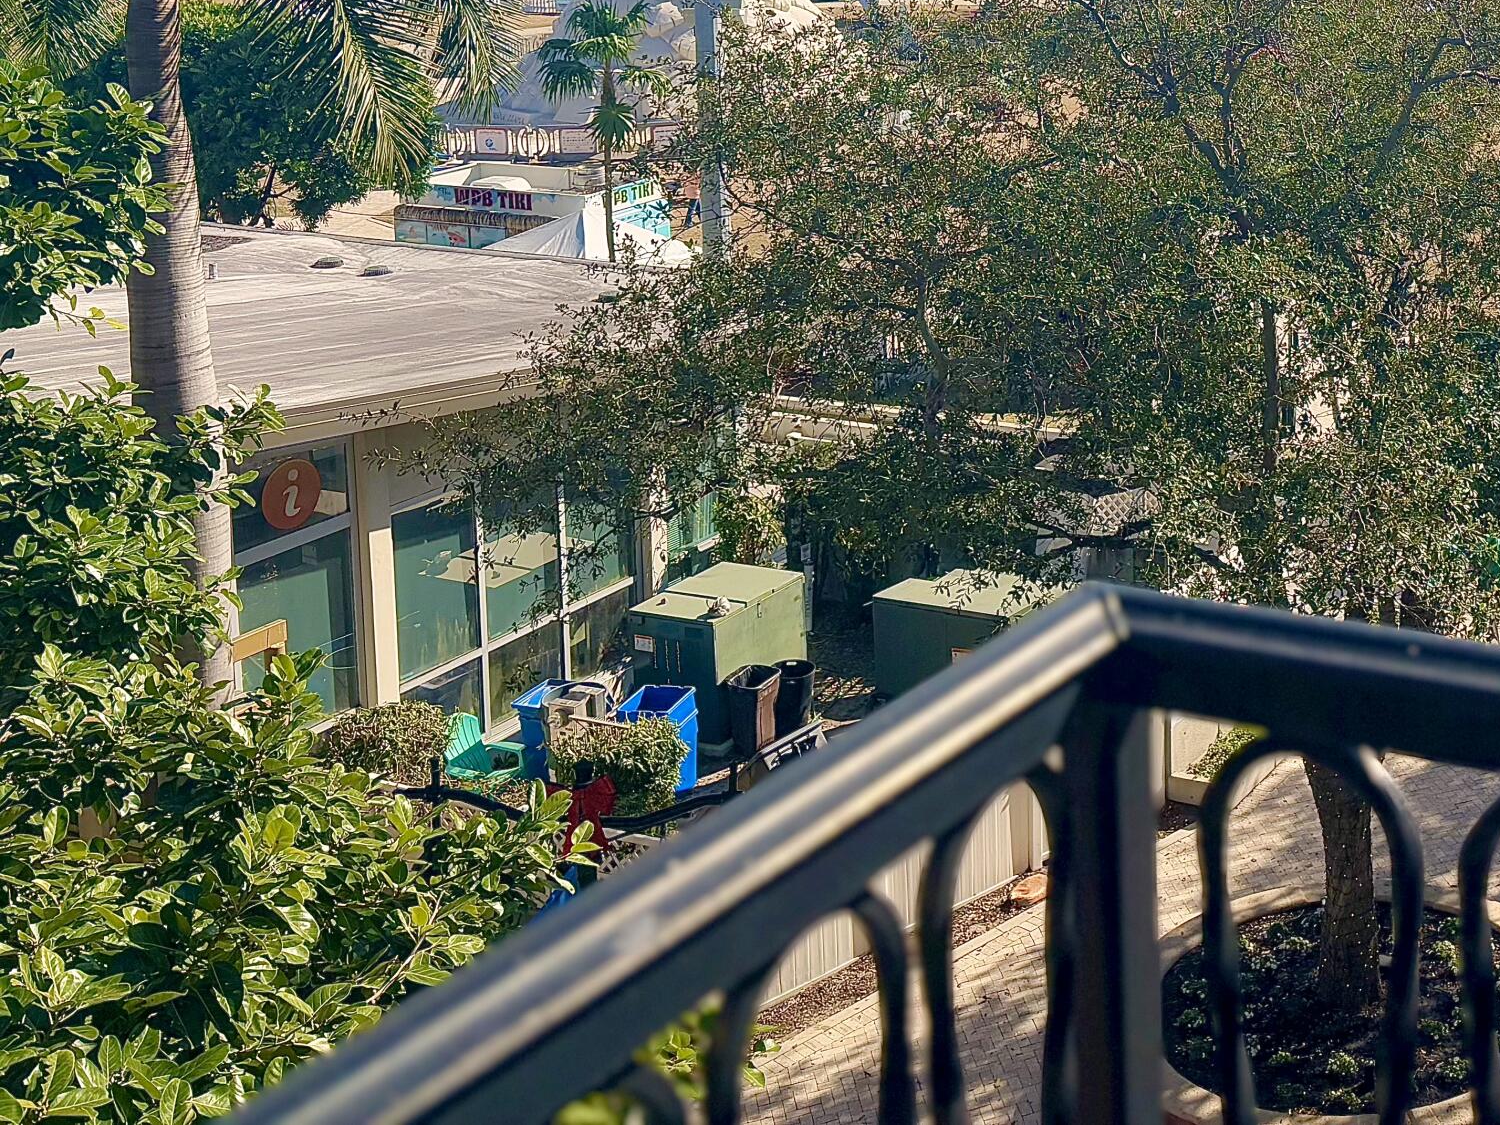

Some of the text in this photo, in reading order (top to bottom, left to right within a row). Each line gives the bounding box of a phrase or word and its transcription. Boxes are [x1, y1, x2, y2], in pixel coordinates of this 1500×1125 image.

[454, 188, 532, 211] WPB TIKI
[630, 181, 654, 200] TIKI
